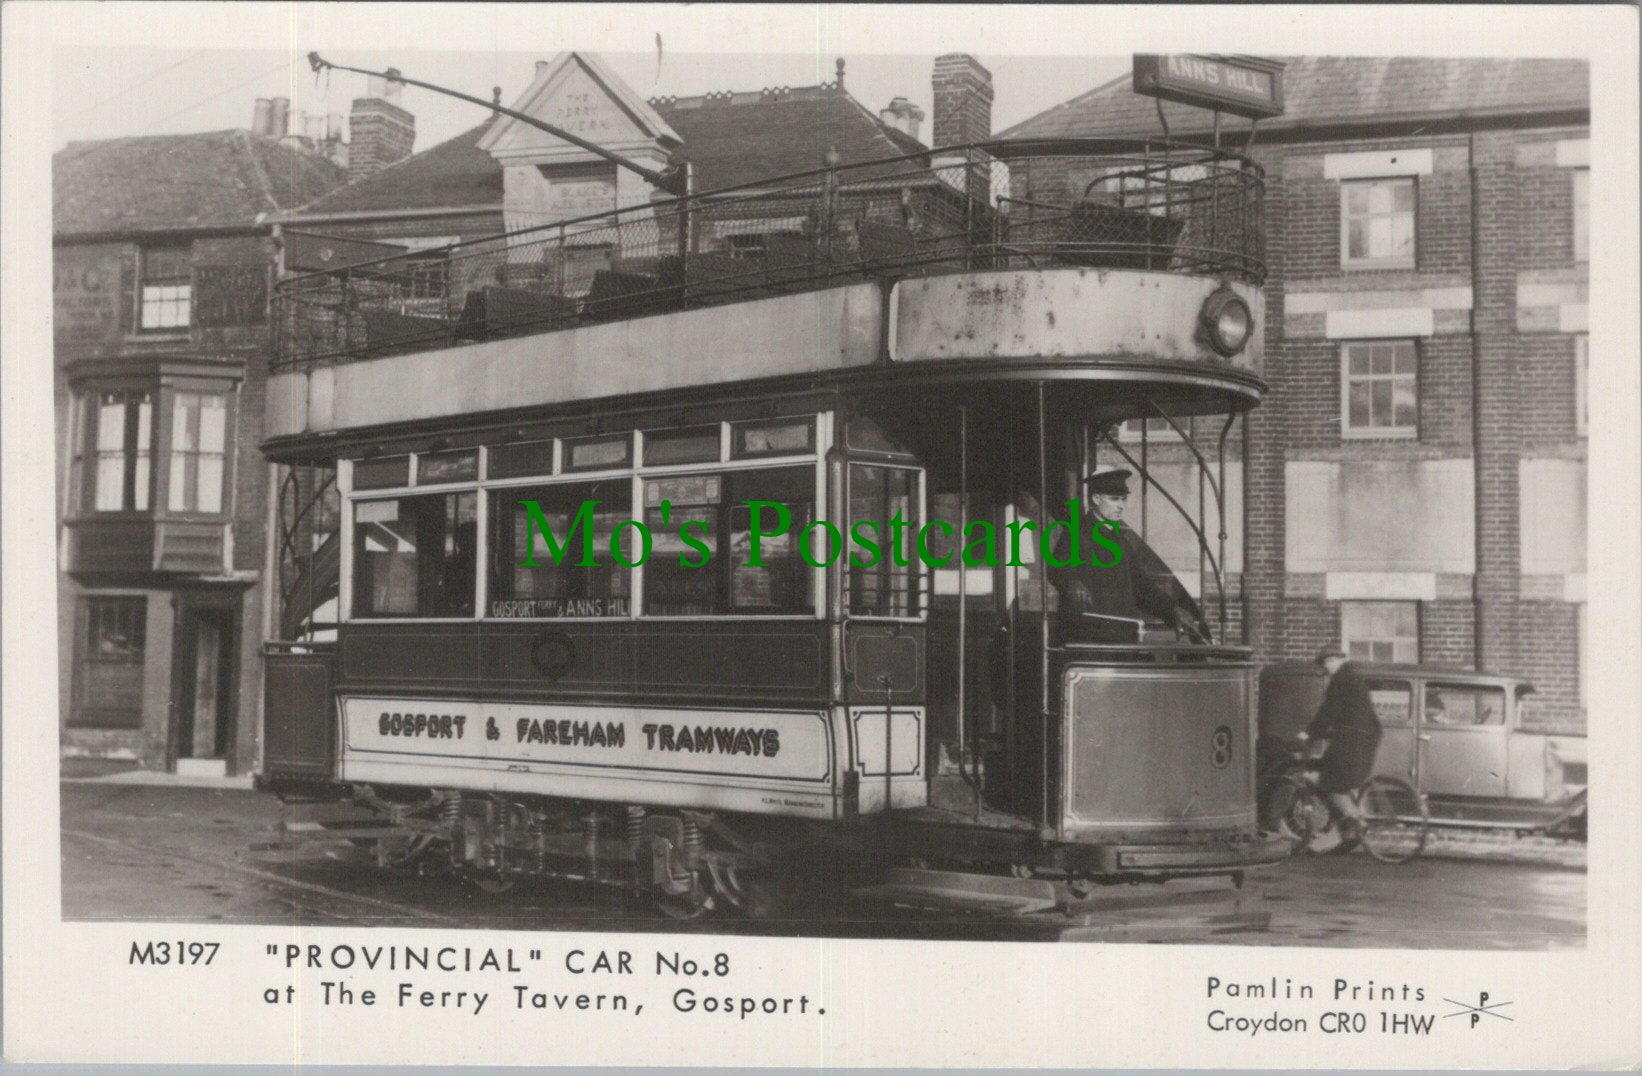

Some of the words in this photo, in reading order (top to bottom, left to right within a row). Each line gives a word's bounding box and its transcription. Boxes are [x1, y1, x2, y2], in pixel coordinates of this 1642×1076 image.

[1168, 55, 1220, 84] ANNS
[1226, 66, 1264, 94] HILL
[492, 601, 536, 617] GOSPORT
[566, 599, 602, 617] ANNS
[379, 713, 466, 741] GOSPORT
[485, 717, 500, 741] &
[517, 718, 626, 748] FAREHAM
[643, 723, 781, 757] TRAMWAYS
[1210, 725, 1233, 770] 8
